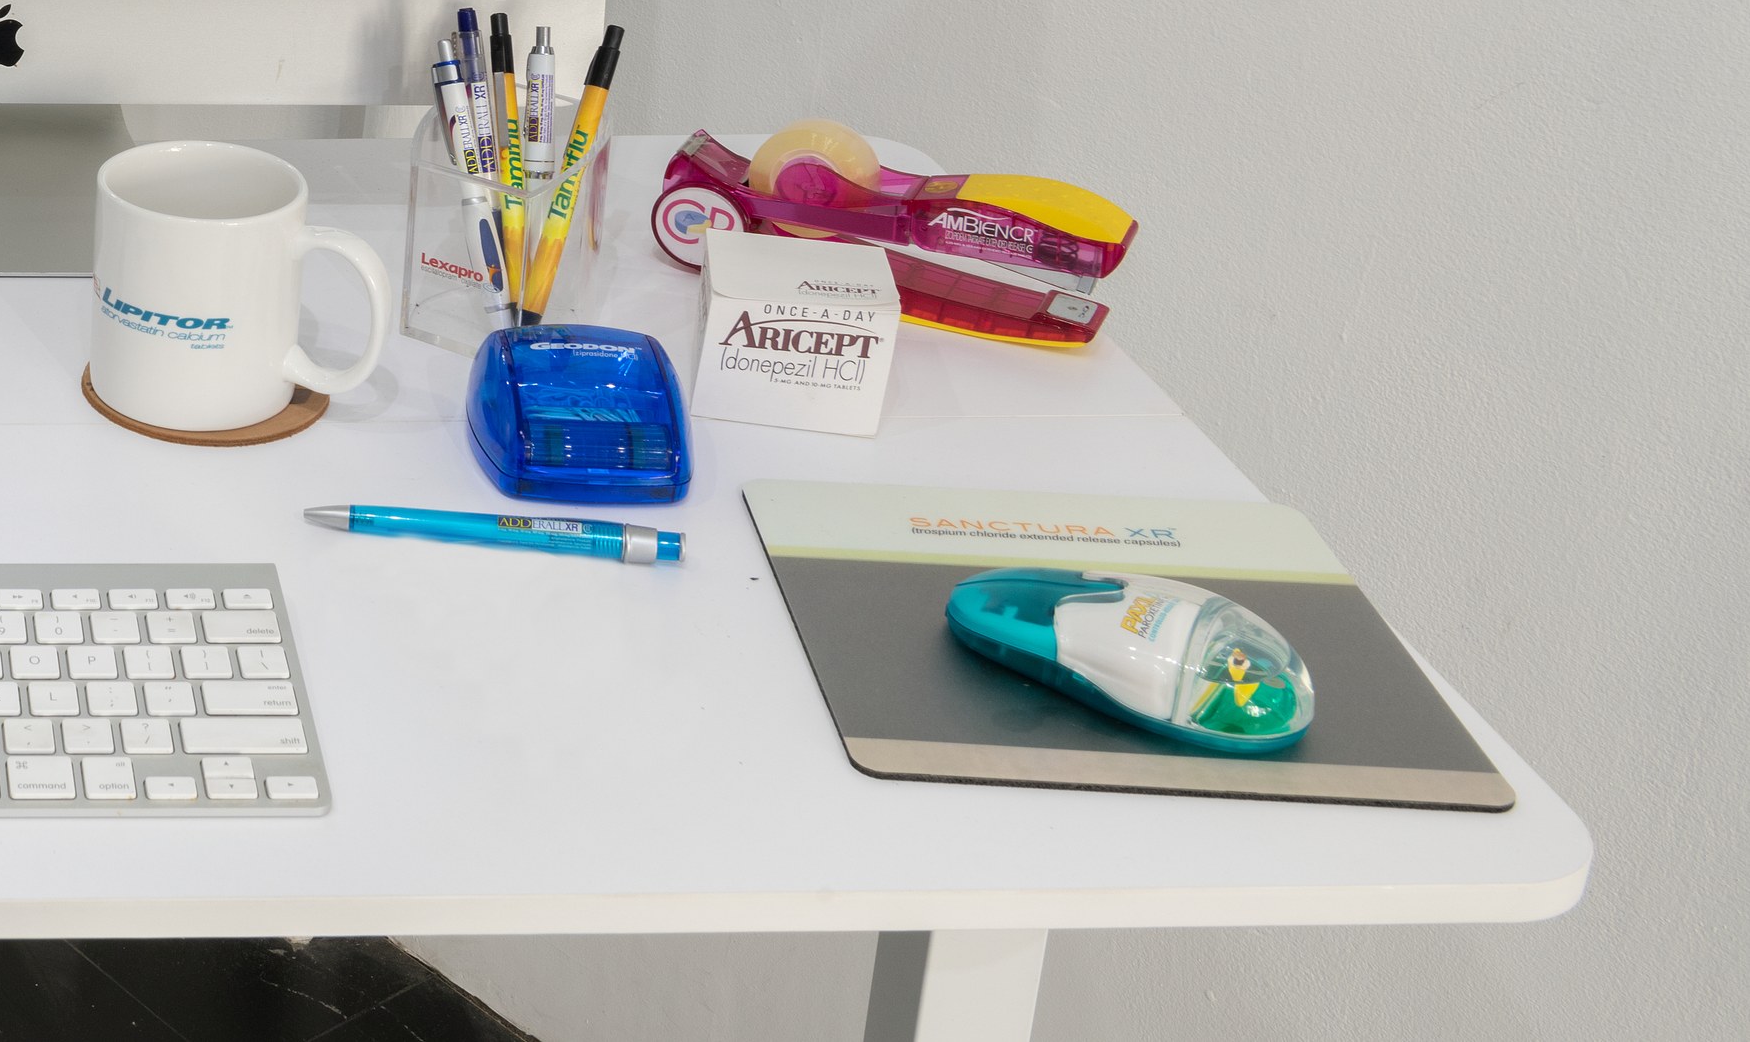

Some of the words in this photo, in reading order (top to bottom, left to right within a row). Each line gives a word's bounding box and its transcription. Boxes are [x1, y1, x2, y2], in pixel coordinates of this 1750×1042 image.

[474, 84, 487, 100] XR
[530, 82, 539, 93] XR
[458, 115, 467, 126] XR
[528, 94, 539, 142] ADDERALL
[475, 104, 496, 173] ADDERALL
[460, 125, 479, 173] ADDERALL
[421, 252, 484, 282] Lexapro
[796, 280, 882, 295] ARICEPT
[102, 287, 231, 330] LIPITOR
[763, 304, 876, 322] ONCE-A-DAY
[100, 305, 165, 337] atorvastatin
[167, 329, 226, 342] calcium
[718, 311, 879, 358] ARICEPT
[530, 342, 636, 354] GEODON
[572, 349, 619, 359] (ziprasidone
[720, 347, 818, 382] (donepezil
[822, 358, 866, 385] HCl)
[833, 383, 861, 391] TABLETS
[499, 517, 565, 531] ADDERALL
[565, 523, 579, 532] XR
[909, 517, 1115, 537] SANCTURA
[1123, 527, 1175, 539] XR
[911, 526, 967, 537] (trospium
[969, 530, 1017, 539] chloride
[1019, 533, 1074, 543] extended
[1077, 535, 1121, 545] release
[1123, 538, 1181, 548] capsules)
[54, 626, 64, 636] 0
[246, 627, 275, 635] delete
[28, 655, 41, 665] O
[87, 655, 97, 665] P
[49, 691, 58, 702] L
[263, 699, 292, 707] return
[279, 737, 301, 745] shift
[17, 782, 67, 790] command
[98, 782, 130, 791] option
